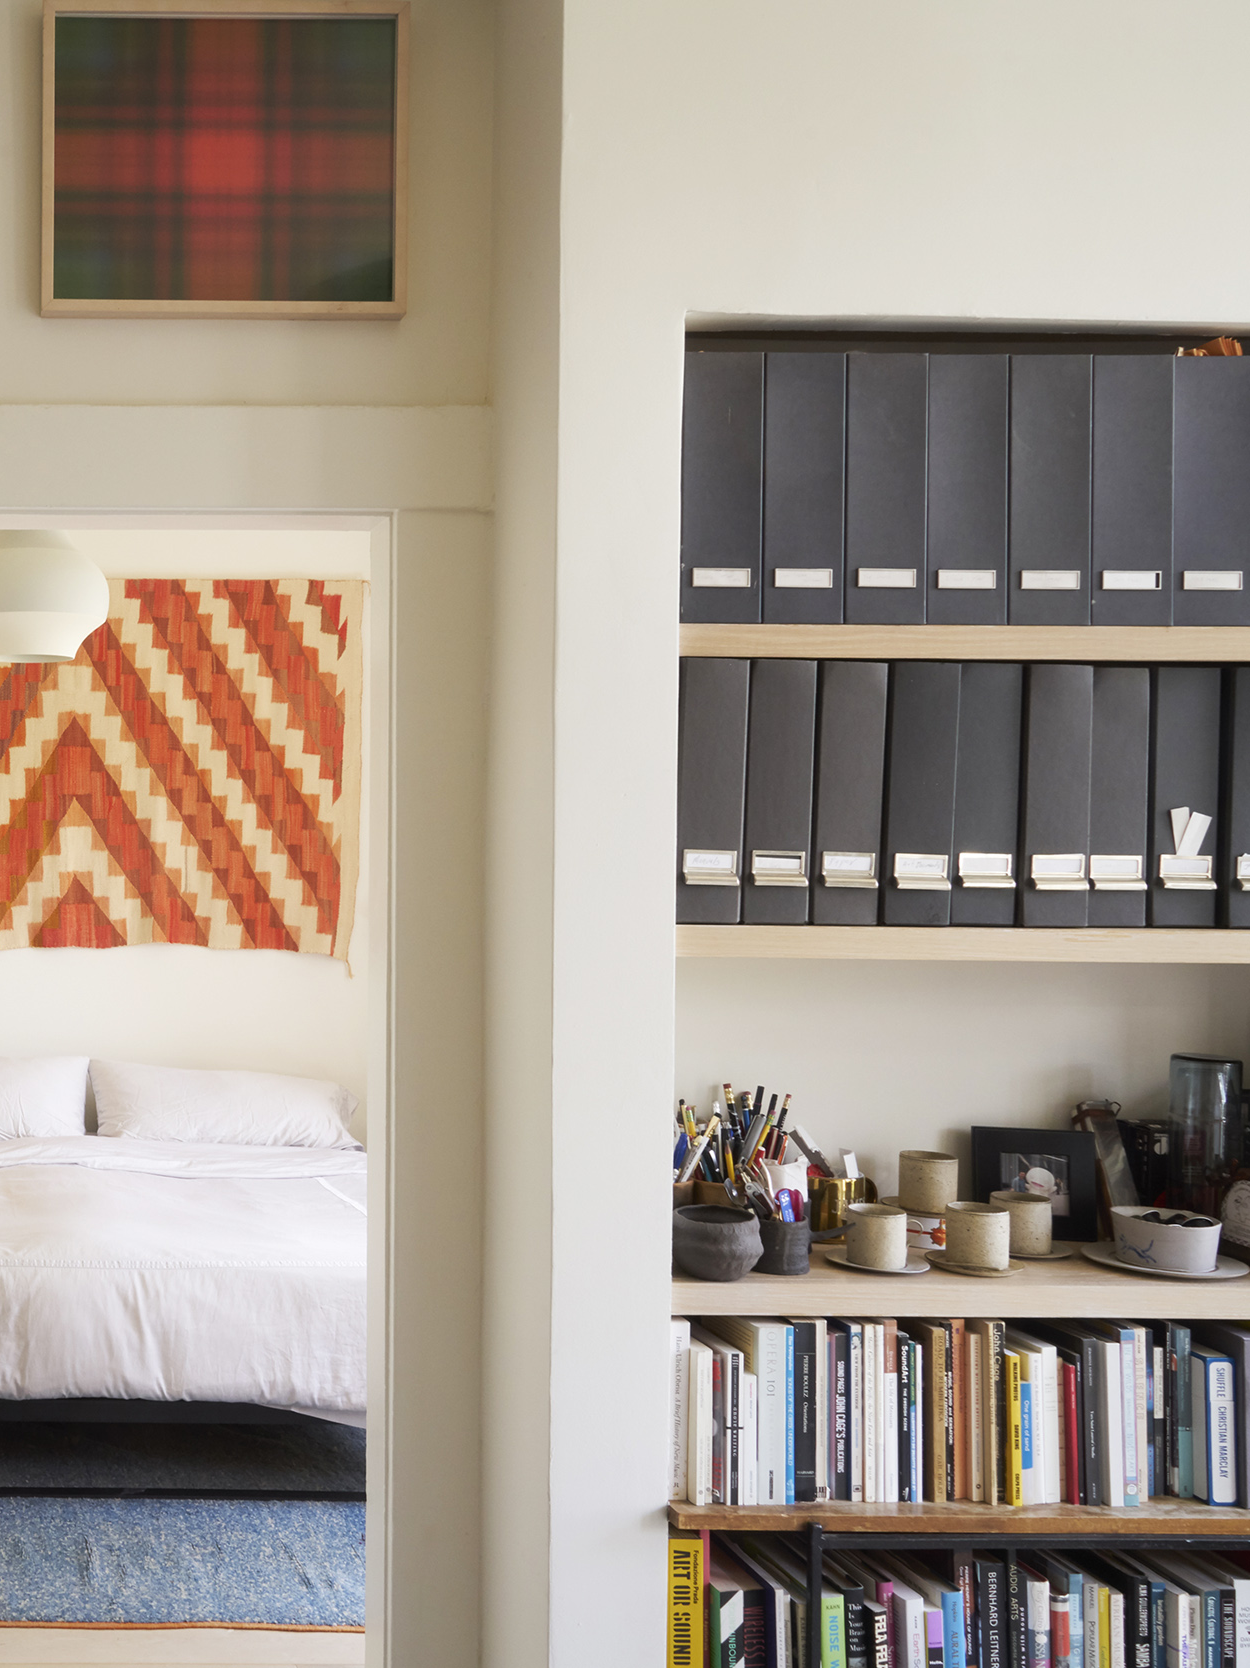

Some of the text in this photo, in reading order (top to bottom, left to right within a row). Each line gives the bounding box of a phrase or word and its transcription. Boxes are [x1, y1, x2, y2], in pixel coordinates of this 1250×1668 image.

[766, 1332, 778, 1374] OPERA
[994, 1328, 1002, 1352] John
[836, 1360, 844, 1378] SOUND
[938, 1363, 944, 1373] TO
[788, 1394, 793, 1402] OF
[836, 1378, 844, 1394] PAGES
[1136, 1358, 1144, 1420] SILENCE
[674, 1404, 682, 1418] Brief
[836, 1394, 846, 1413] JOHN
[673, 1418, 681, 1440] History
[836, 1414, 846, 1438] CAGE'S
[1216, 1368, 1228, 1479] SHUFFLE CHRISTIAN MARCLAY
[1010, 1564, 1018, 1593] AUDIO
[1138, 1584, 1148, 1596] ALMA
[673, 1550, 691, 1666] ART OR SOUND
[988, 1572, 998, 1626] BERNHARD
[1010, 1598, 1019, 1620] ARTS
[874, 1614, 887, 1644] FELA
[1114, 1598, 1122, 1637] AFRICAN
[1156, 1600, 1164, 1646] brutality garden
[1224, 1603, 1234, 1658] THE SOUNDSCAPE
[744, 1606, 766, 1658] WIRELESS
[828, 1616, 839, 1652] NOISE
[912, 1633, 920, 1658] Earth
[951, 1630, 960, 1660] AURAL
[1088, 1620, 1096, 1648] POPULAR
[1136, 1644, 1150, 1668] SAMBA
